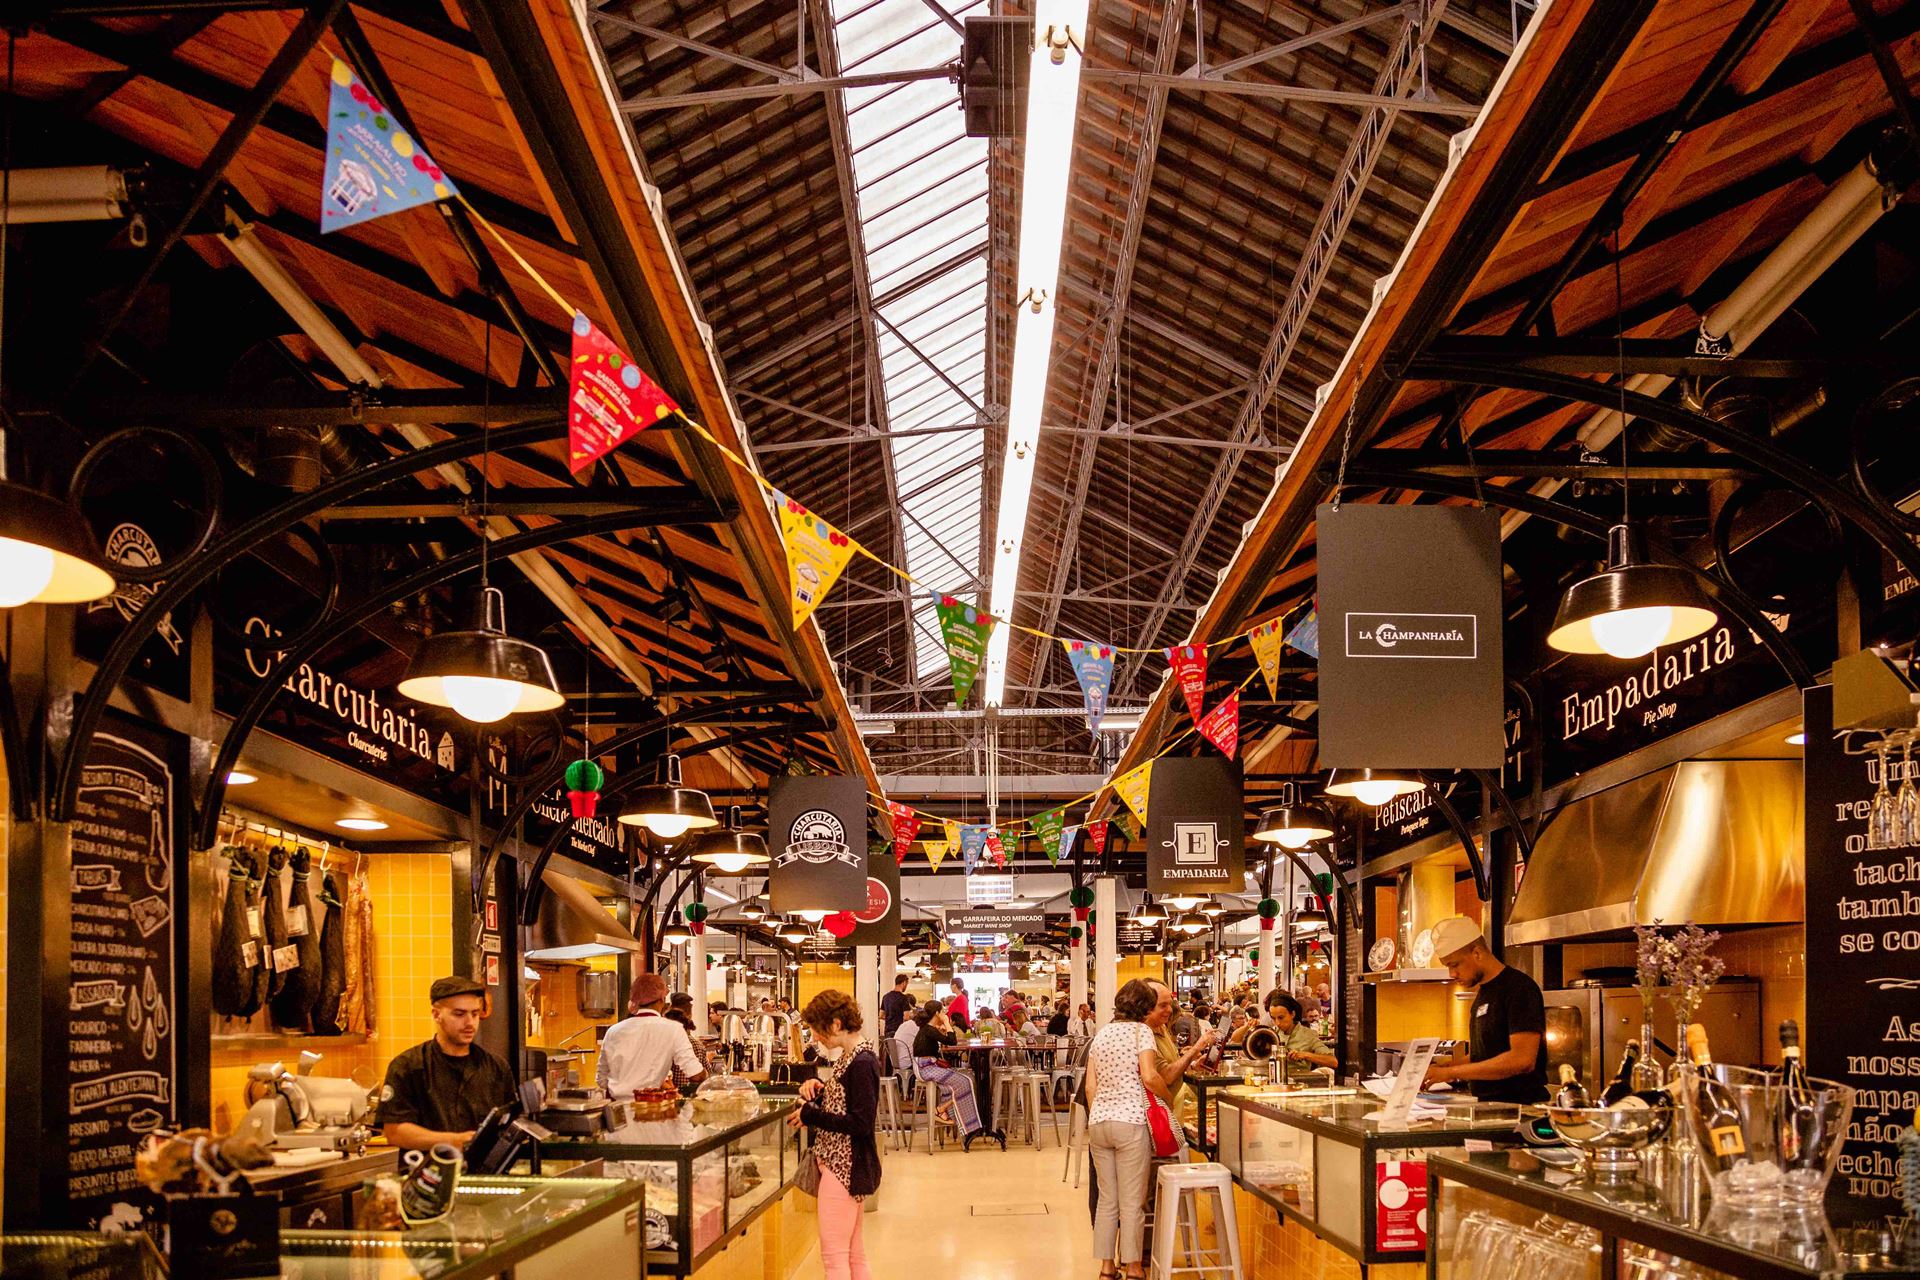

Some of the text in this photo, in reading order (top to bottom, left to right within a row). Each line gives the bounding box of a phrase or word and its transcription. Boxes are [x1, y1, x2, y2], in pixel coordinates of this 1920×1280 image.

[1359, 631, 1373, 640] LA
[1562, 627, 1735, 741] Empadaria
[1643, 702, 1677, 727] Pie Shop
[348, 731, 388, 762] Charcuterie
[794, 813, 842, 837] CHARCUTARIA
[797, 842, 838, 853] LISBOA
[1186, 832, 1207, 855] E
[1163, 868, 1229, 879] EMPADARIA
[867, 898, 887, 906] ESIA
[1839, 931, 1875, 954] se
[78, 985, 115, 1001] ASSADOS
[69, 1021, 107, 1036] CHOURIÇO
[69, 1119, 110, 1137] PRESUNTO
